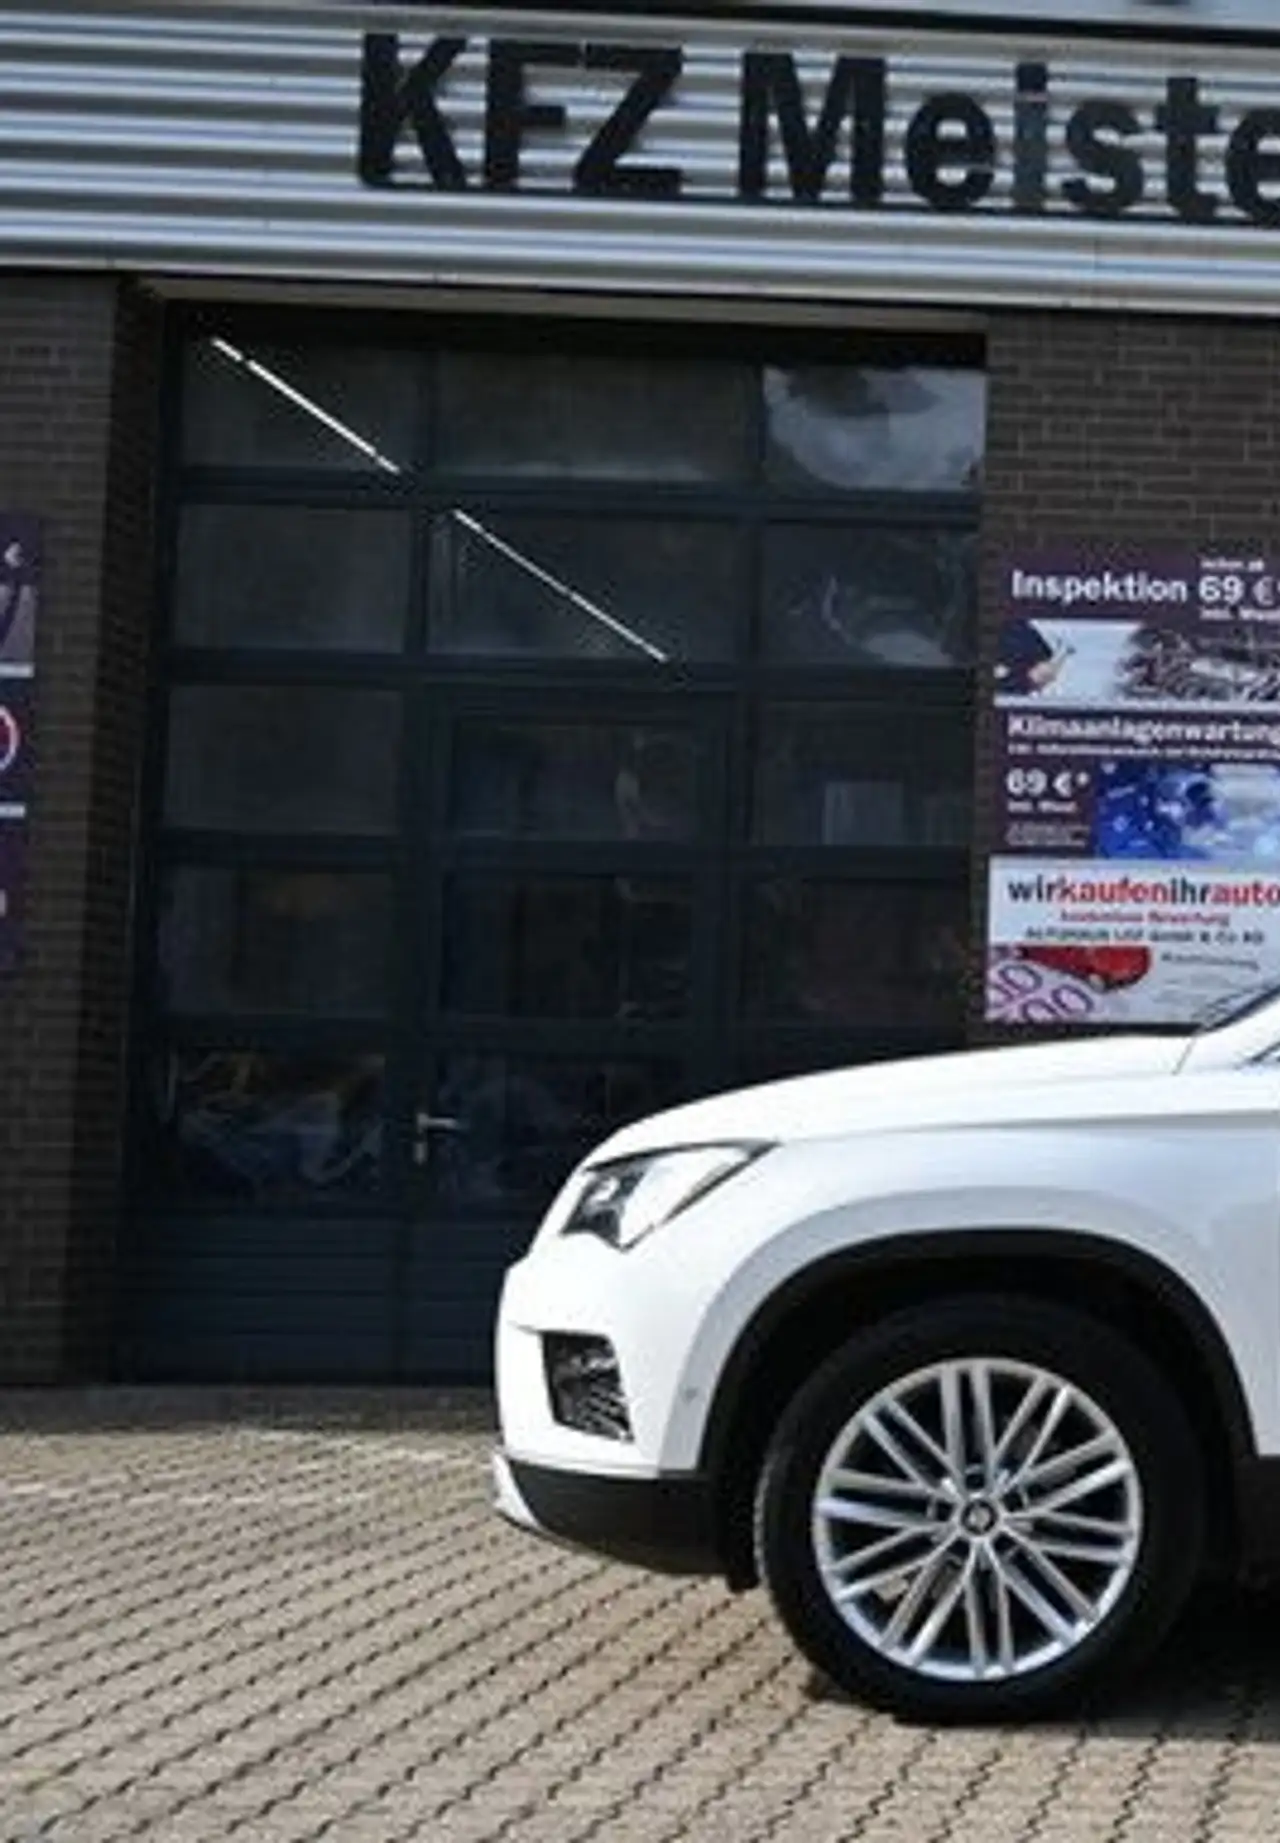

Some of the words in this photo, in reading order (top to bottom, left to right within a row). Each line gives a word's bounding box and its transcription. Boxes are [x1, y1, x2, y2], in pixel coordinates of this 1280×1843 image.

[358, 32, 684, 196] KFZ
[1011, 568, 1188, 604] Inspektion
[1198, 575, 1245, 605] 69
[1006, 766, 1047, 797] 69
